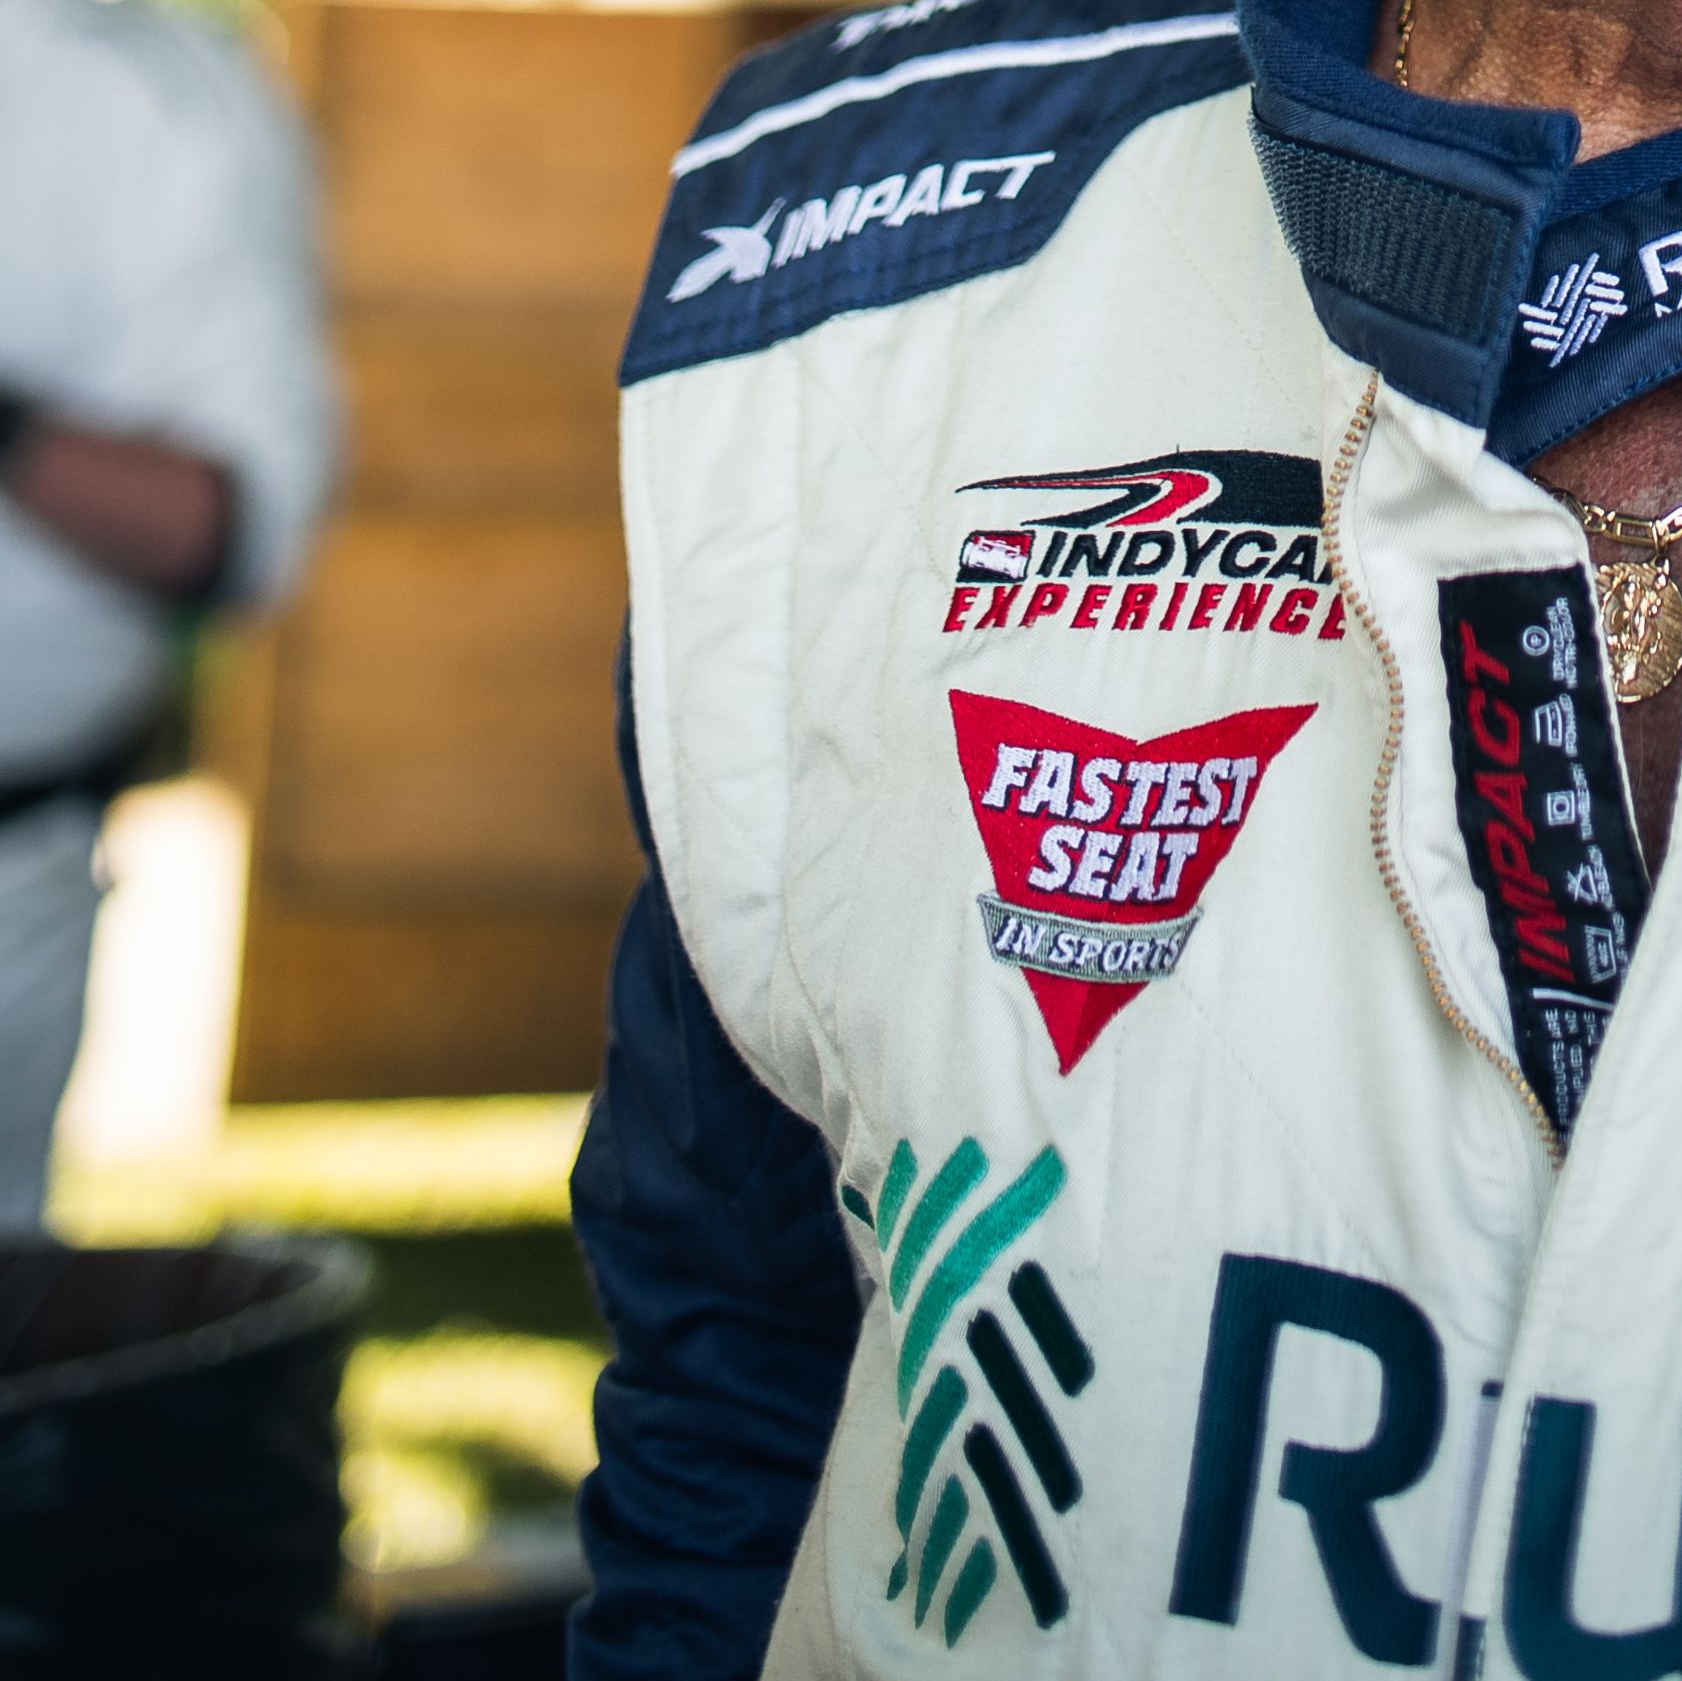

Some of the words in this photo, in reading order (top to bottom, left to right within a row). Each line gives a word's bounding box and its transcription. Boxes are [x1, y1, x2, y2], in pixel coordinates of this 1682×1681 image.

[772, 149, 1056, 269] IMPACT
[1037, 529, 1334, 586] INDYCA
[981, 742, 1258, 828] FASTEST
[1460, 620, 1575, 985] IMPACT
[1027, 824, 1200, 904] SEAT
[995, 915, 1046, 957] IN
[1048, 931, 1181, 974] SPORTS
